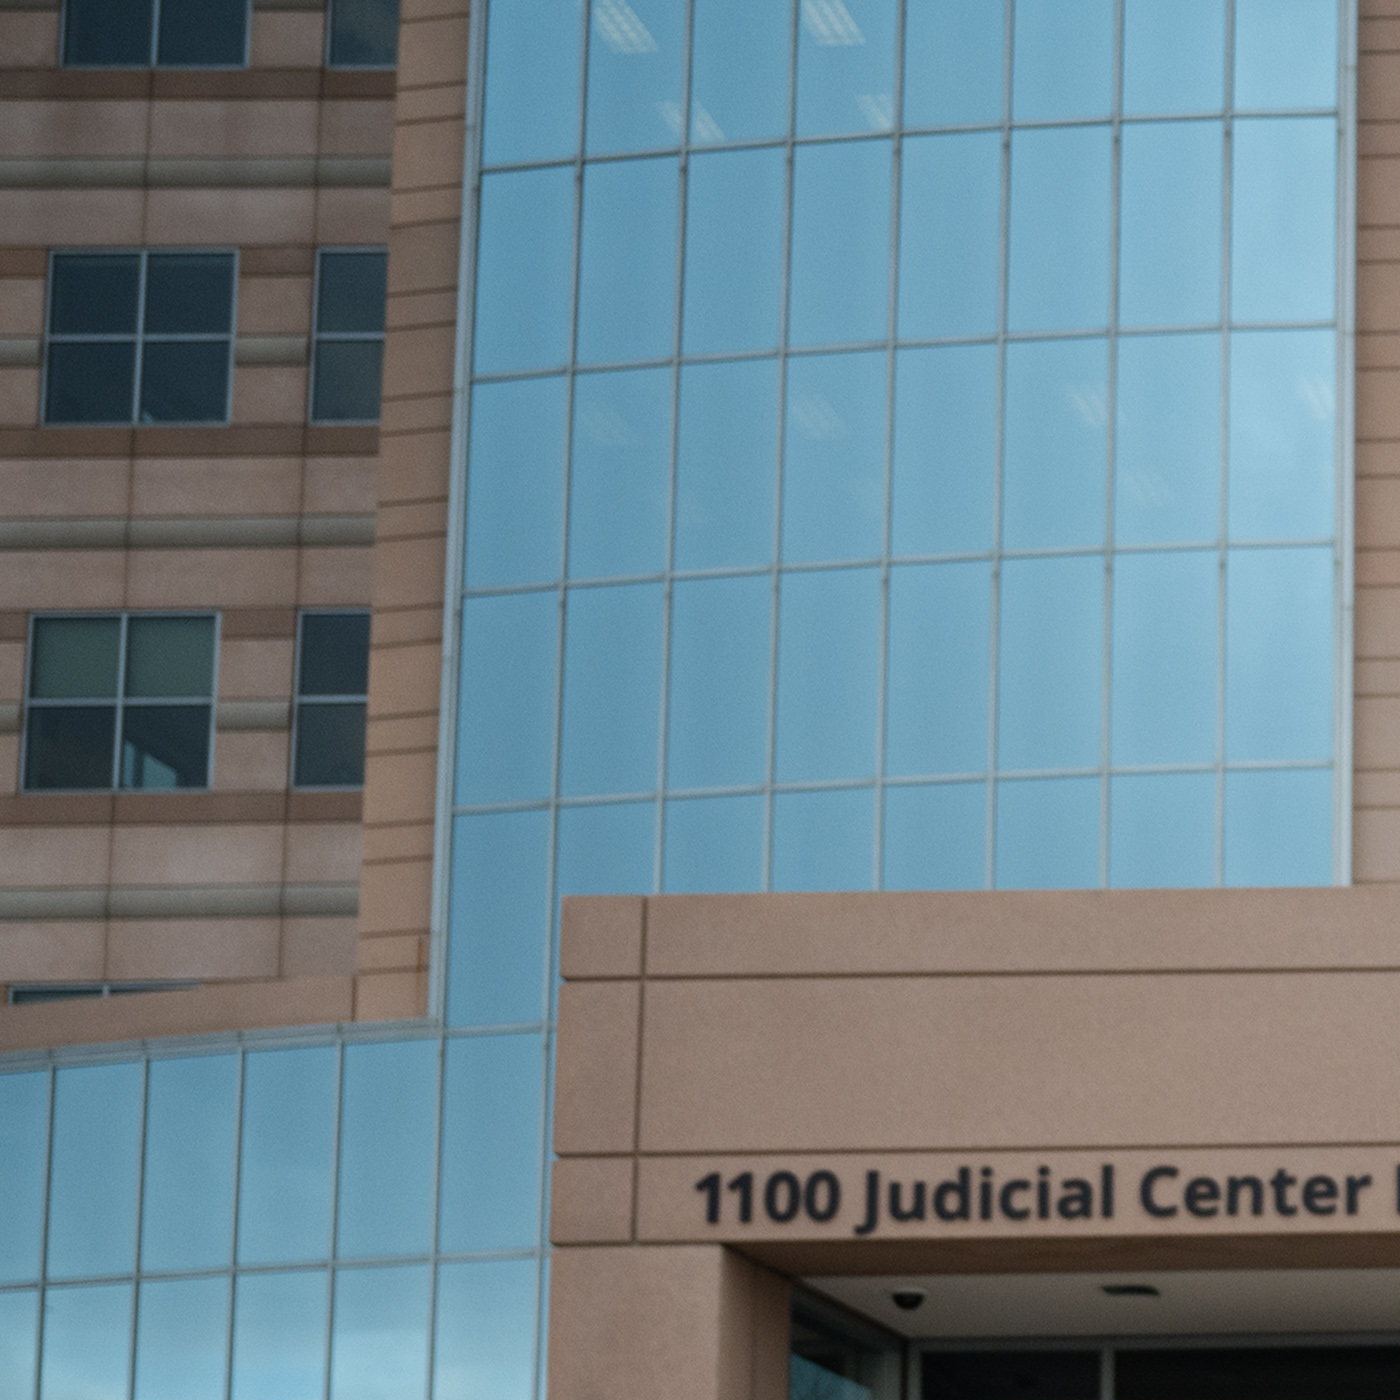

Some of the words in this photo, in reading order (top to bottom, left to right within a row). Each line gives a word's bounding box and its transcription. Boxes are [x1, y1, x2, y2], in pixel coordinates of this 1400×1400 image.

[696, 1171, 841, 1225] 1100
[854, 1164, 1115, 1236] Judicial
[1139, 1164, 1372, 1219] Center
